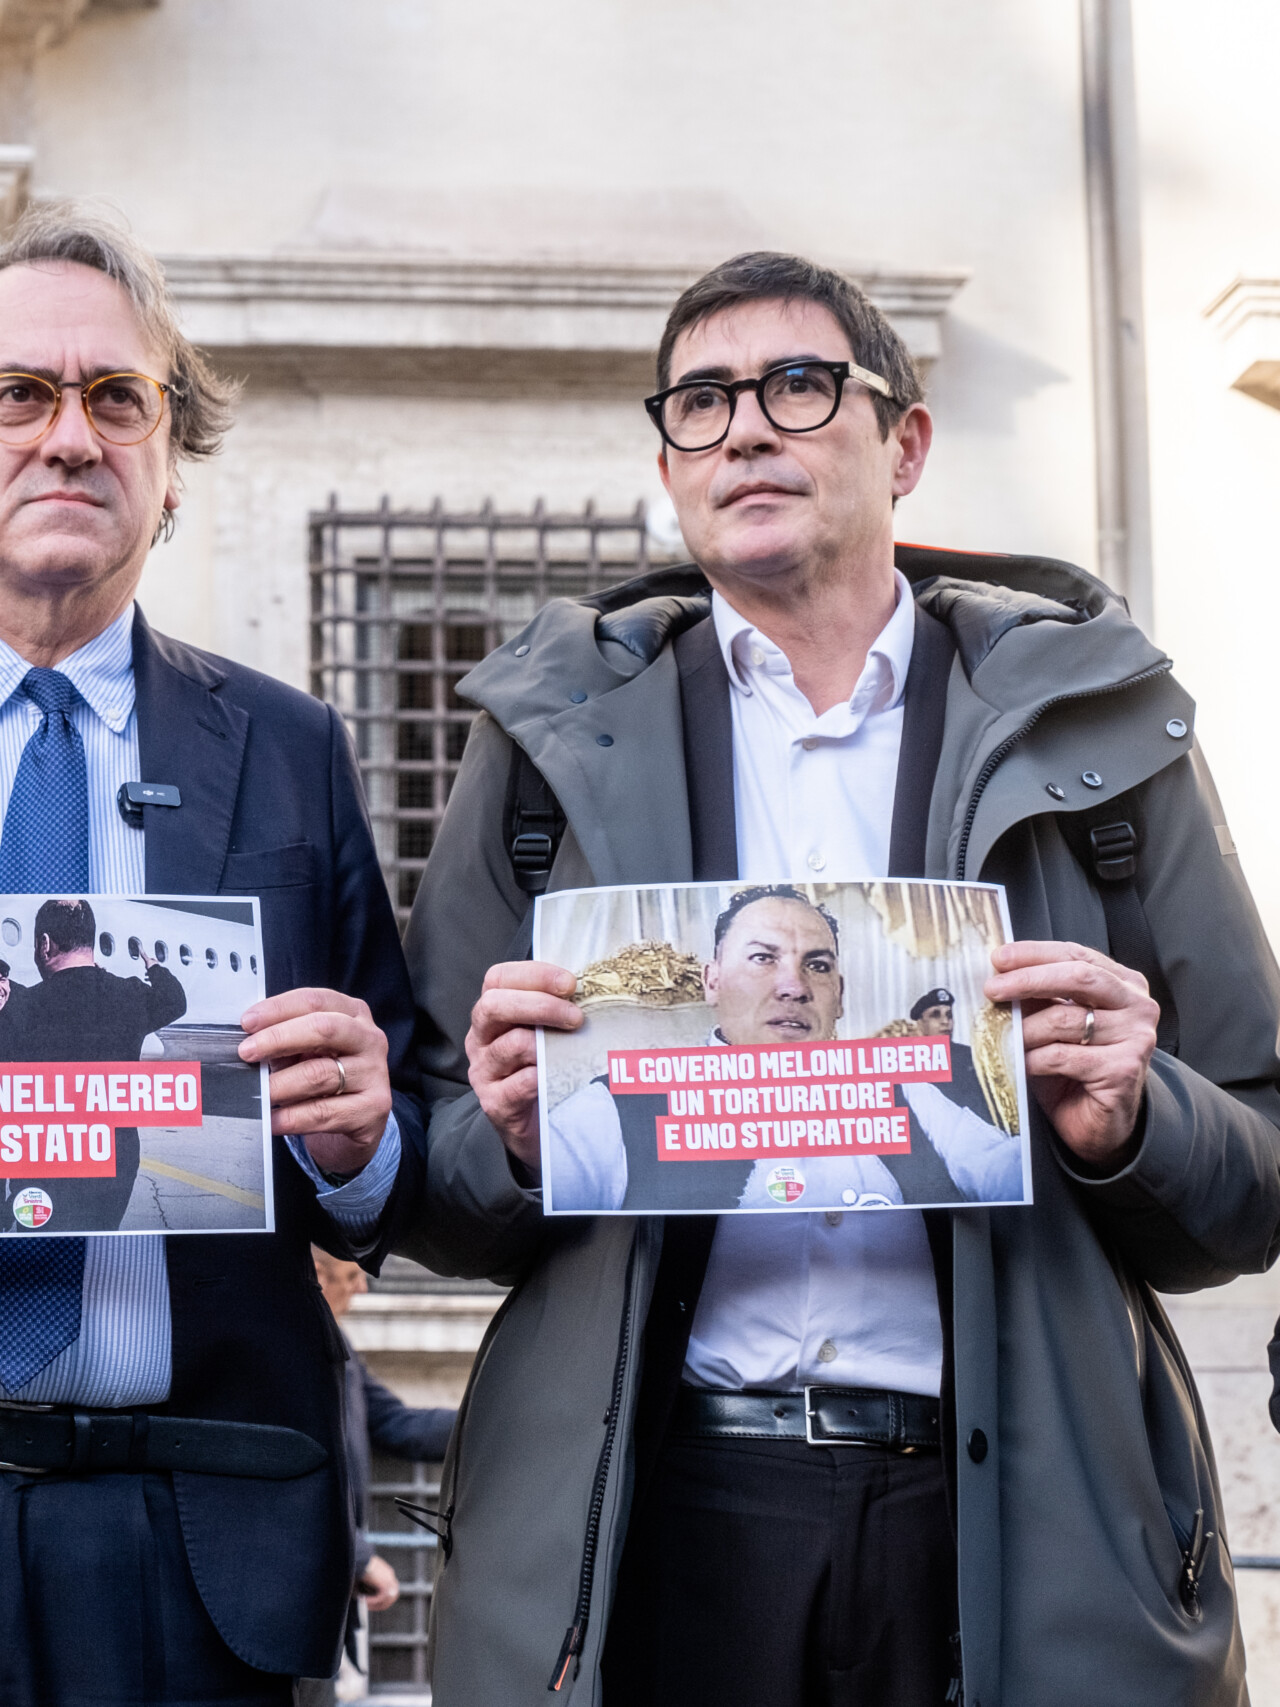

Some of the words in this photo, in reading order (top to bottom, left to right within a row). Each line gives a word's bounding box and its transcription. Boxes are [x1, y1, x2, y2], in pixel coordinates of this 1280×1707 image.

[610, 1057, 635, 1084] IL
[638, 1052, 756, 1084] GOVERNO
[759, 1048, 854, 1080] MELONI
[857, 1043, 950, 1075] LIBERA
[669, 1089, 705, 1117] UN
[708, 1081, 893, 1116] TORTURATORE
[0, 1123, 112, 1163] STATO
[663, 1123, 682, 1151] E
[684, 1121, 737, 1150] UNO
[740, 1115, 908, 1149] STUPRATORE
